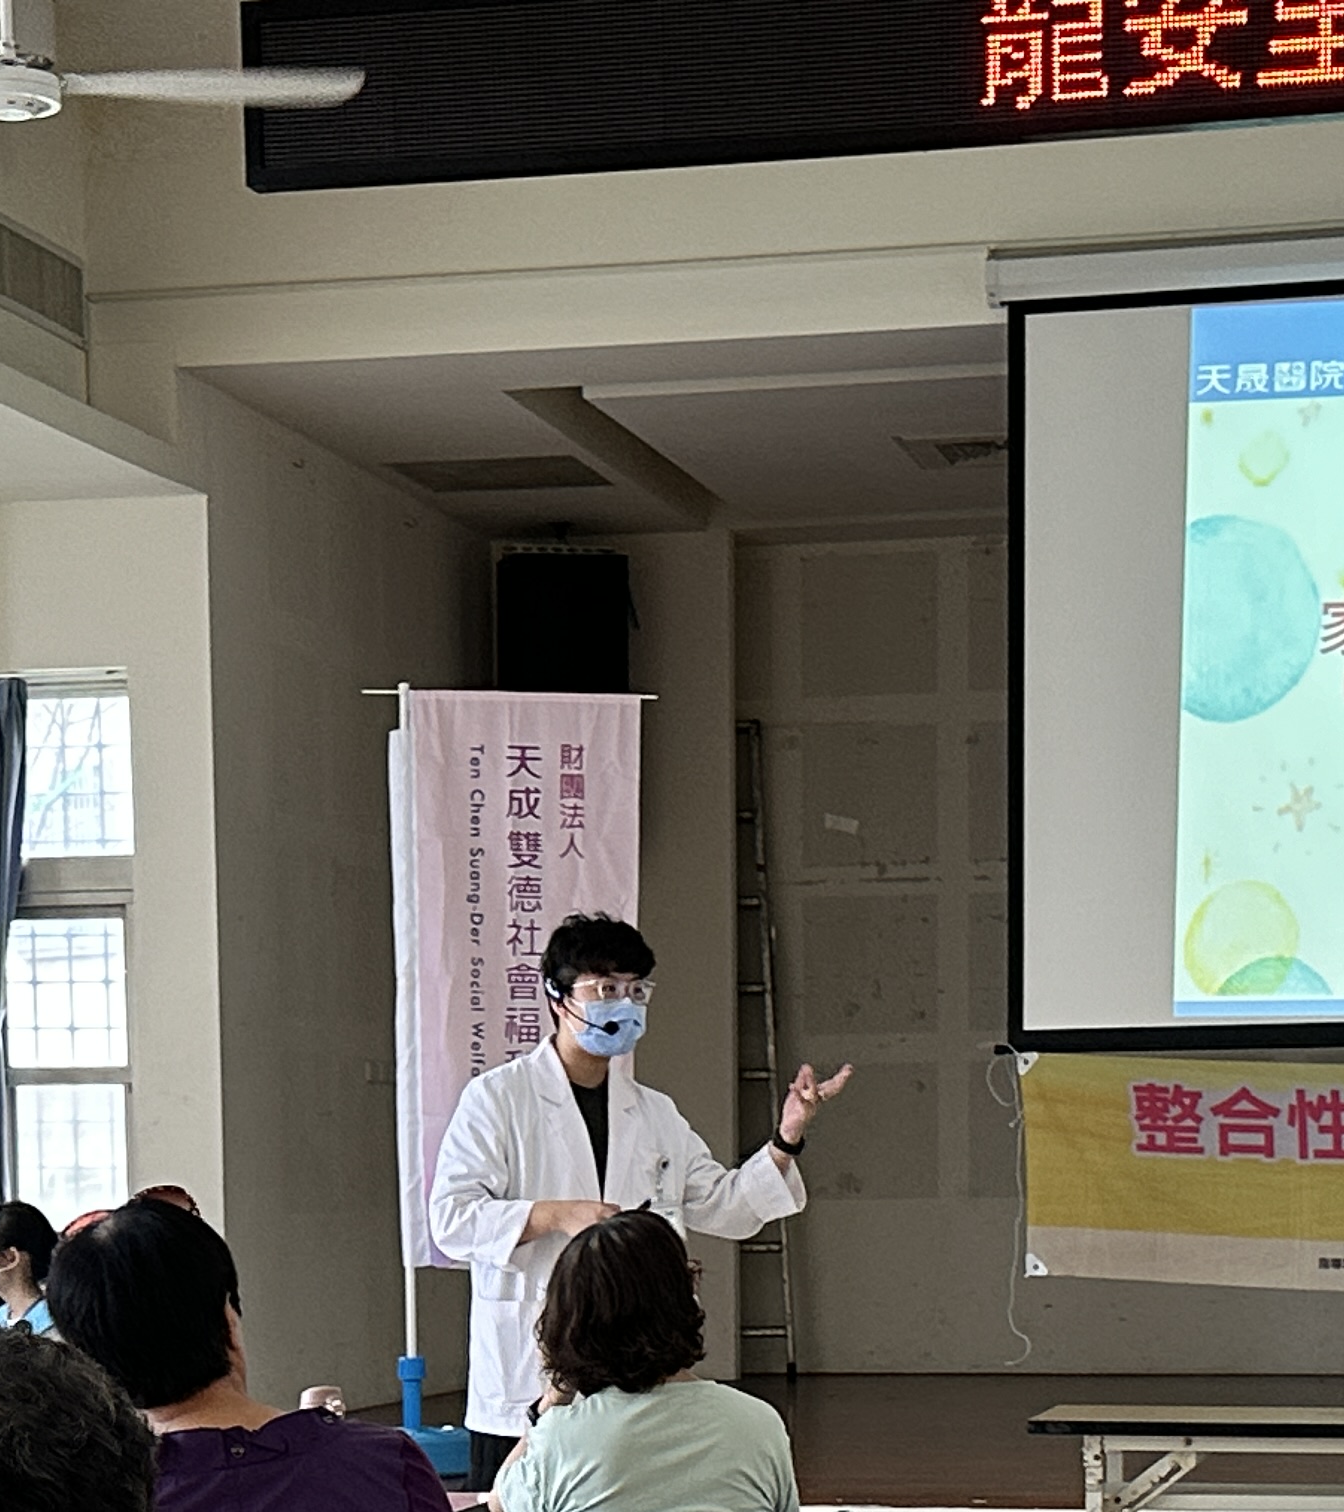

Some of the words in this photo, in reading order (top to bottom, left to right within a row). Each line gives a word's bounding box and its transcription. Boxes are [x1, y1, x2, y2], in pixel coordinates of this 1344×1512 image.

[559, 743, 585, 860] 財團法人
[470, 956, 485, 1012] Social
